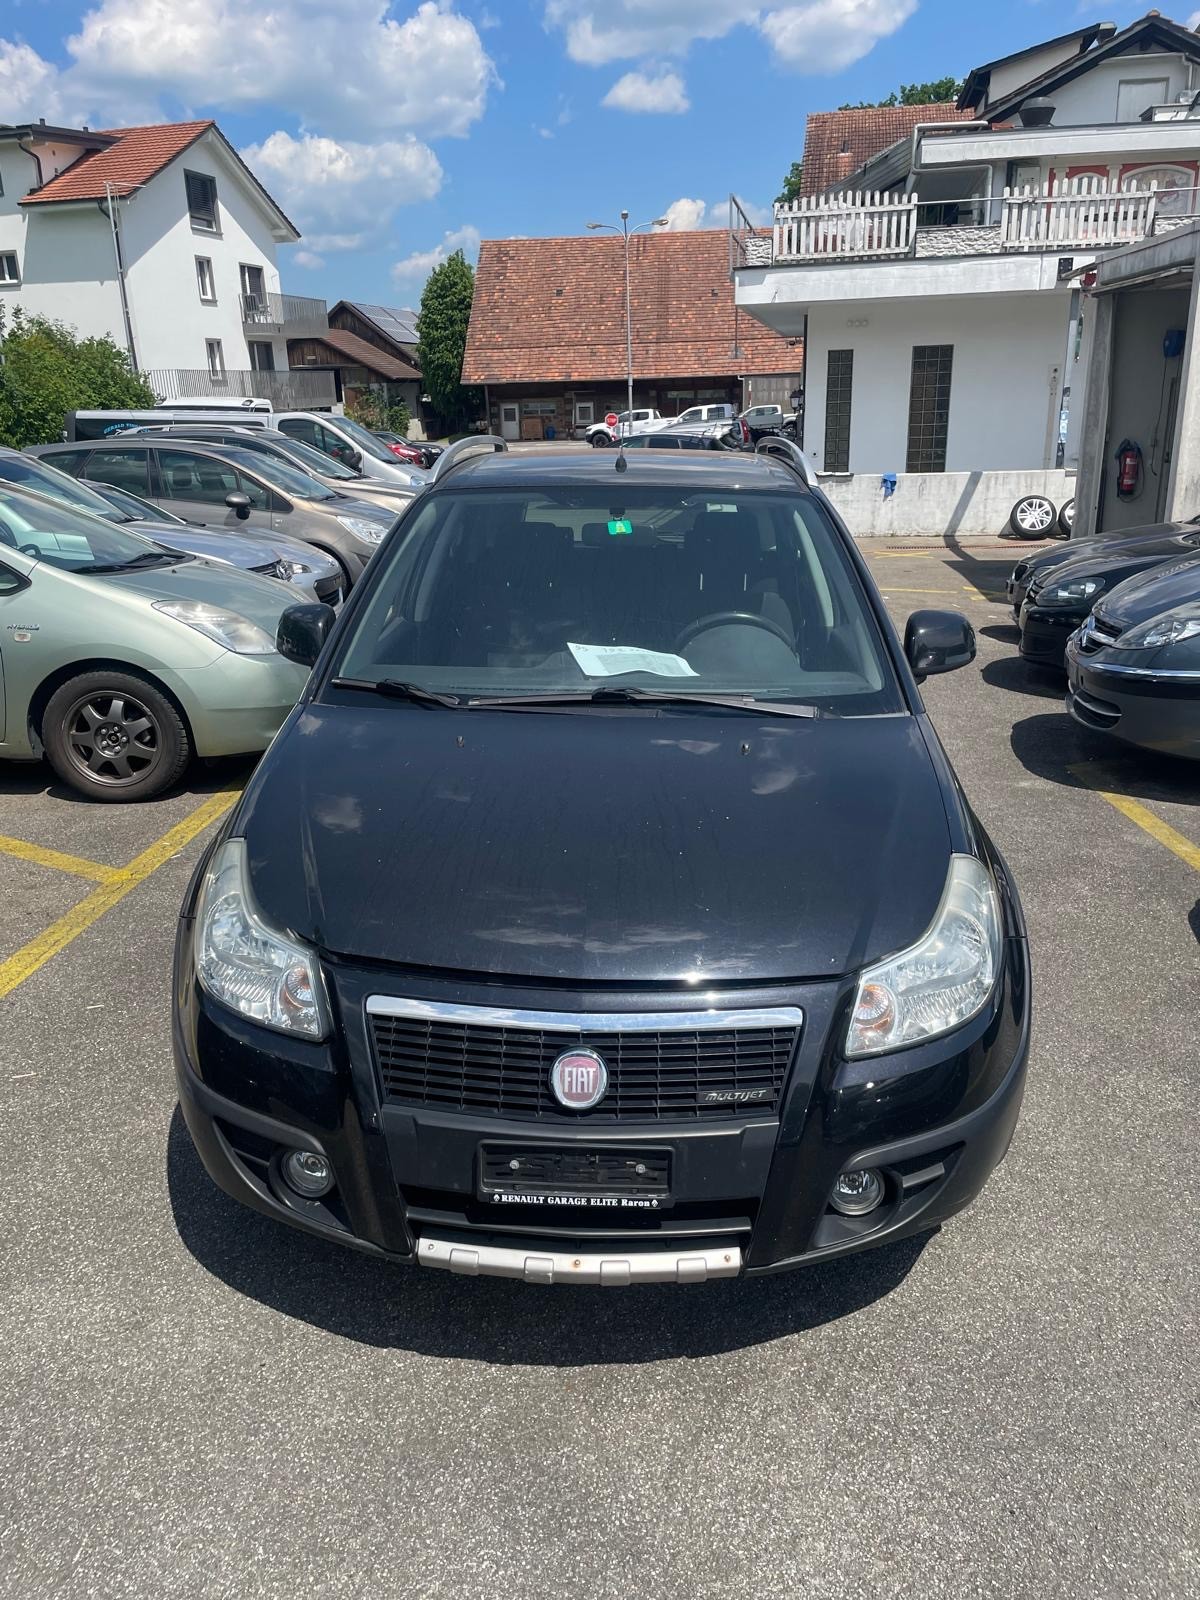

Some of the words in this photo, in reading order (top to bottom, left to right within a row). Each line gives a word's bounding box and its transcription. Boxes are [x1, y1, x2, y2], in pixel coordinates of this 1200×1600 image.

[564, 1067, 596, 1093] FIAT
[704, 1089, 767, 1102] MULTIJET
[501, 1194, 545, 1204] RENAULT
[547, 1196, 587, 1206] GARAGE
[590, 1197, 618, 1207] ELITE
[621, 1198, 650, 1208] Raron
